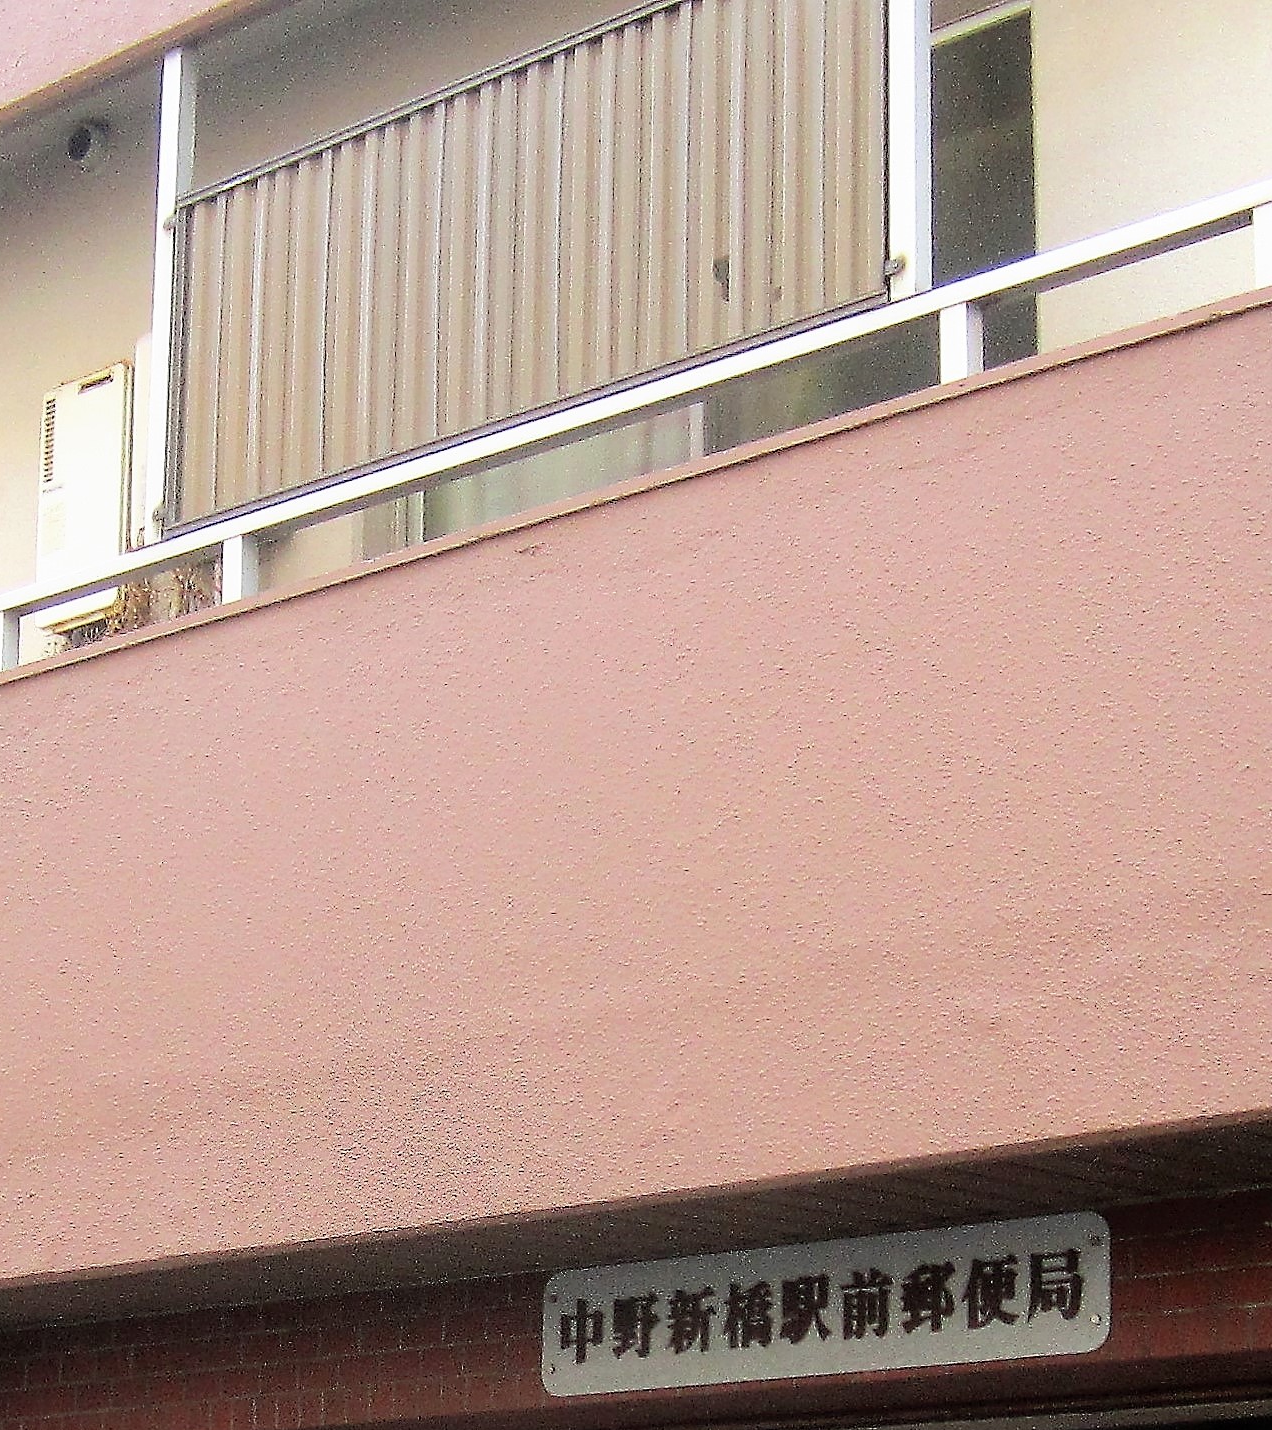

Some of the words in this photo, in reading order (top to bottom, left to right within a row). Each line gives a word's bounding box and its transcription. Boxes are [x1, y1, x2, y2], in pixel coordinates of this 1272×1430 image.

[559, 1248, 1083, 1366] 中野新橋駅前郵便局
